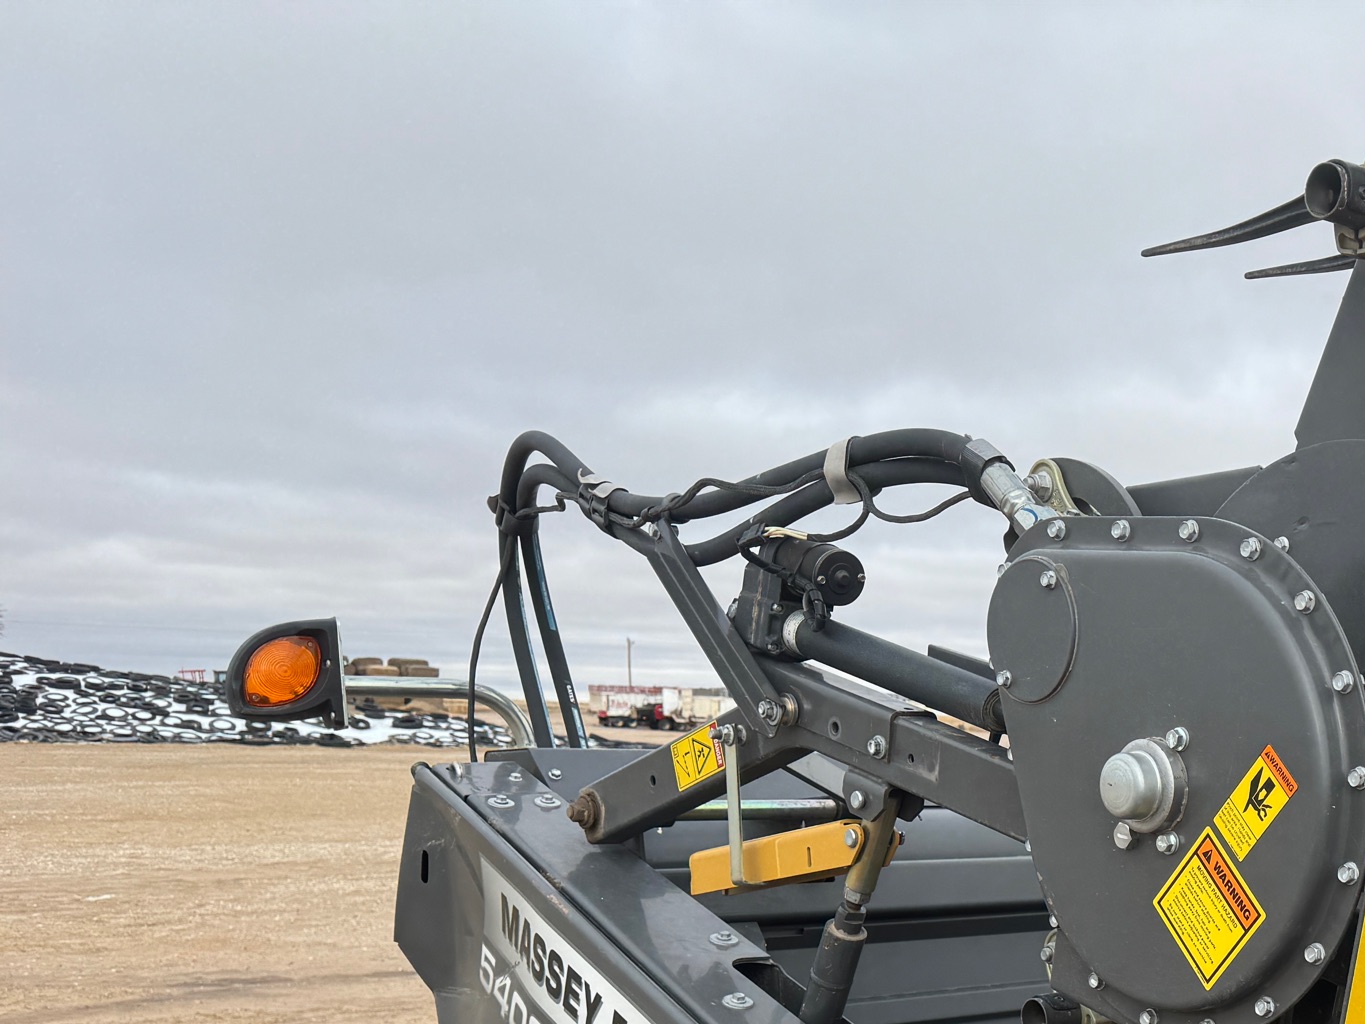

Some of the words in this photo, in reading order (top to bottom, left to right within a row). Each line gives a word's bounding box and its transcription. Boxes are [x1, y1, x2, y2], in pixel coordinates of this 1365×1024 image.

[1269, 755, 1295, 794] WARNING
[1196, 865, 1213, 890] MOVING
[1211, 888, 1223, 905] PART
[1220, 903, 1238, 929] HAZARD
[1213, 860, 1252, 922] WARNING
